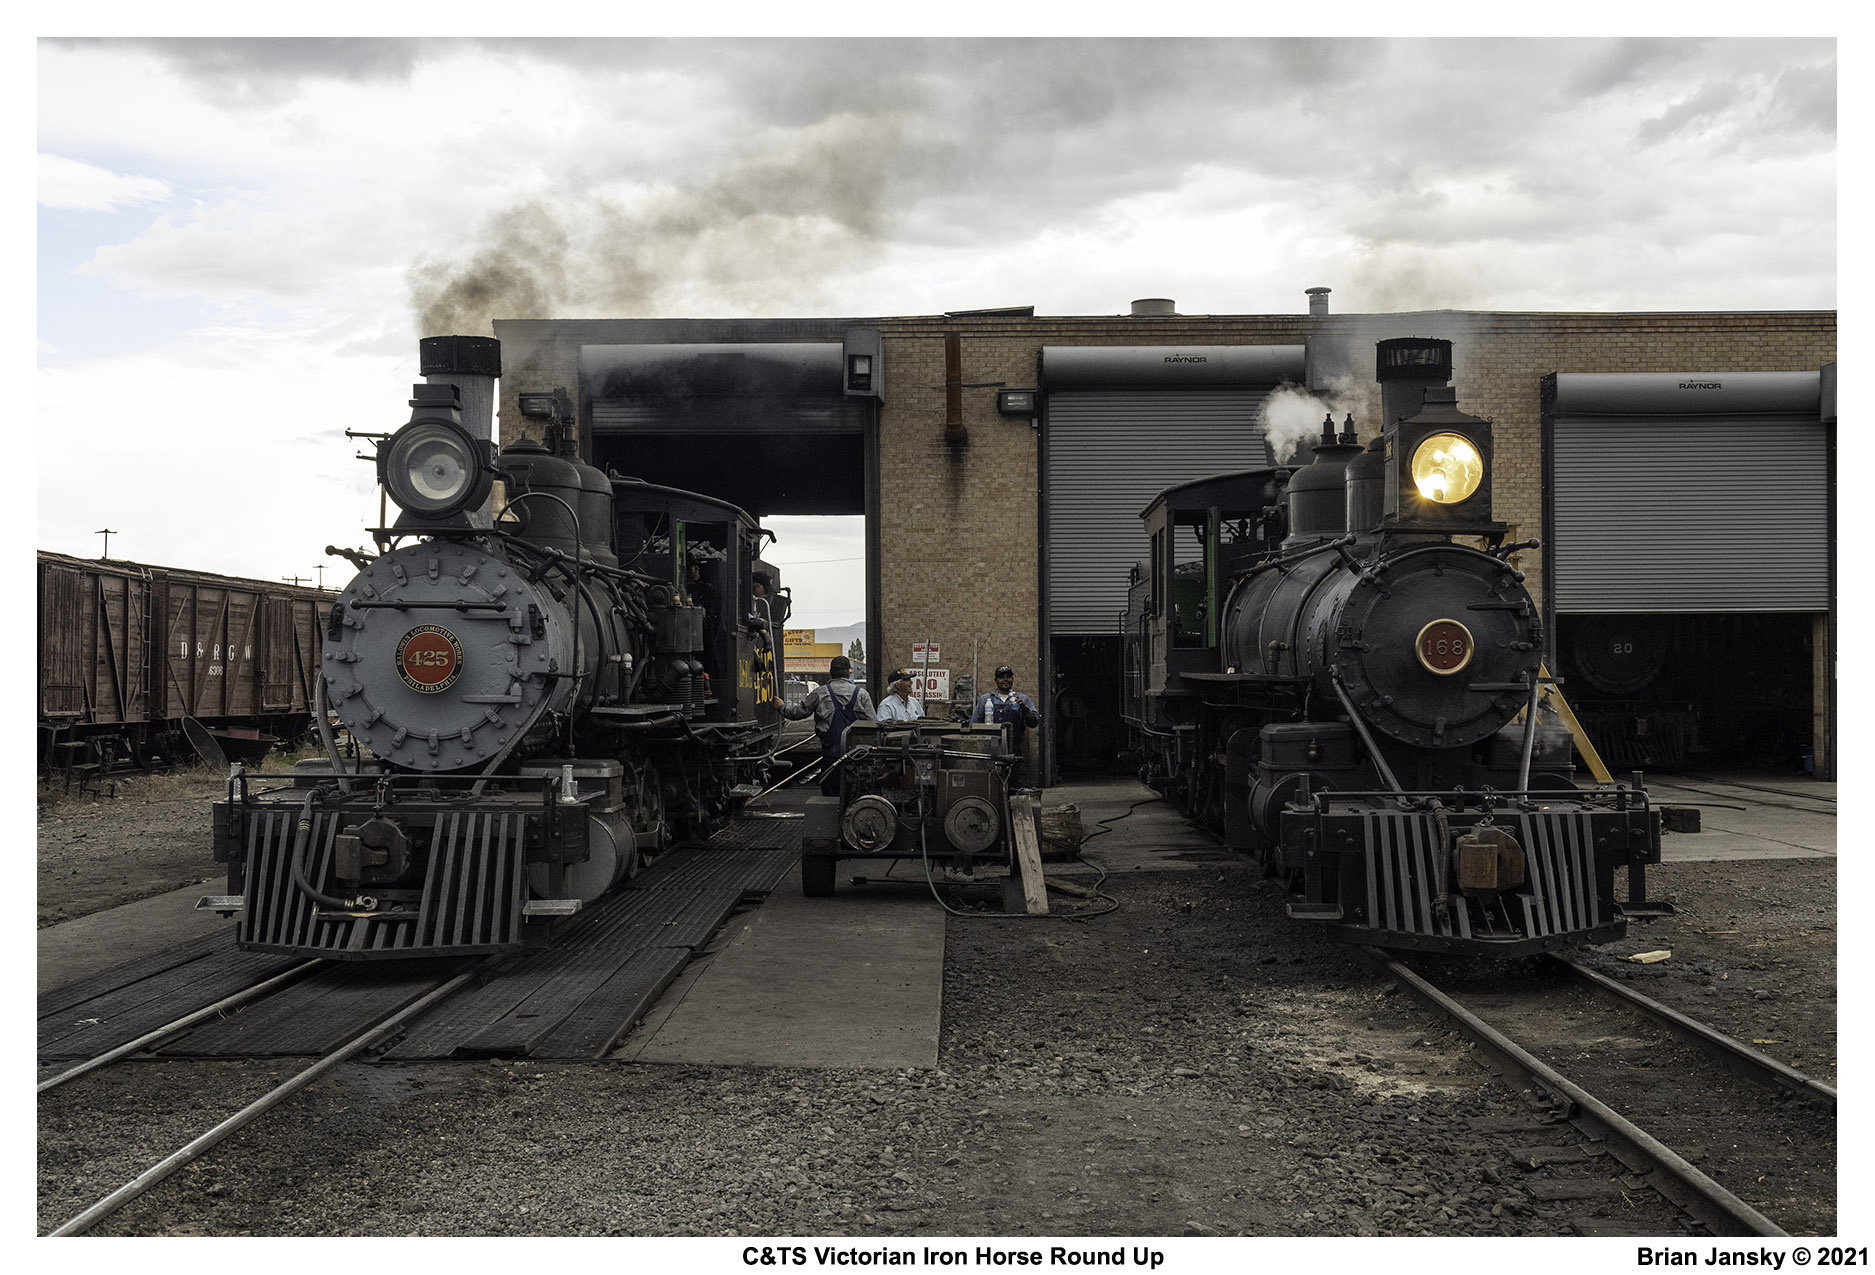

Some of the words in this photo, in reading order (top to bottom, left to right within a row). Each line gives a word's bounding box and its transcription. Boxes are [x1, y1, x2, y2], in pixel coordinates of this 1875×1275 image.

[1679, 382, 1722, 390] RAYNOR
[180, 641, 188, 660] D
[396, 635, 411, 665] BALDWIN
[410, 626, 454, 642] LOCOMOTIVE
[453, 641, 463, 665] WORKS
[1426, 639, 1464, 656] 168
[1613, 643, 1633, 653] 20
[408, 650, 449, 667] 425
[915, 678, 938, 690] NO
